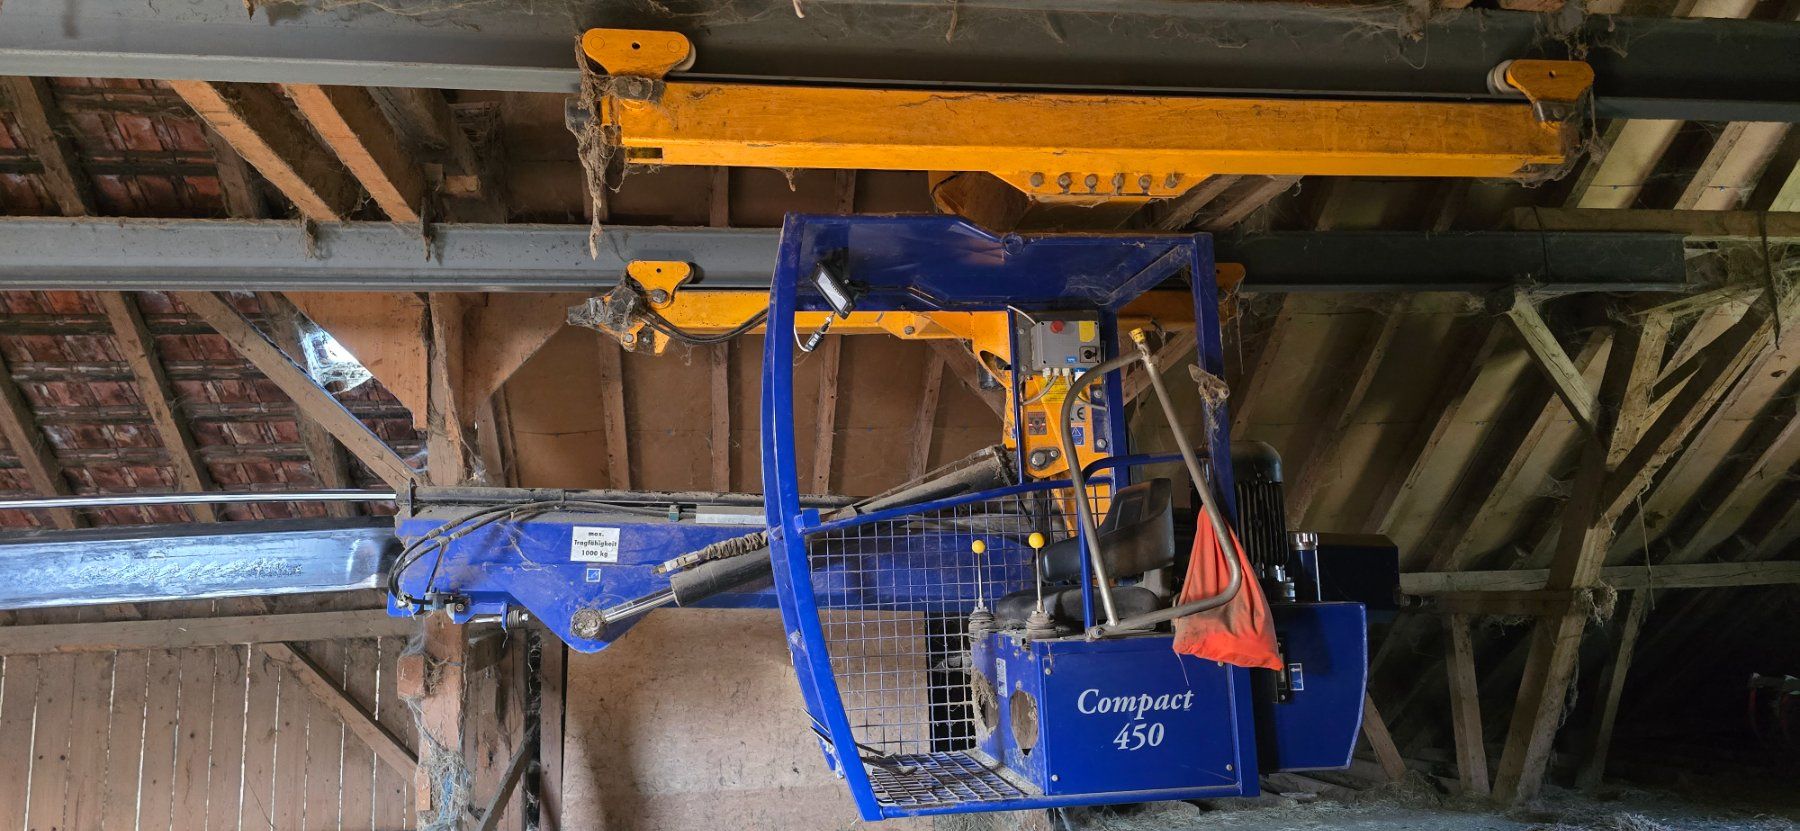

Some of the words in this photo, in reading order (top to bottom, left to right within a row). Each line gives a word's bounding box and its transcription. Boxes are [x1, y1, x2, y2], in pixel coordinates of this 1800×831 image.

[574, 539, 617, 547] Tragfähigkeit
[600, 550, 608, 558] kg
[1077, 688, 1195, 720] Compact
[1112, 722, 1165, 751] 450
